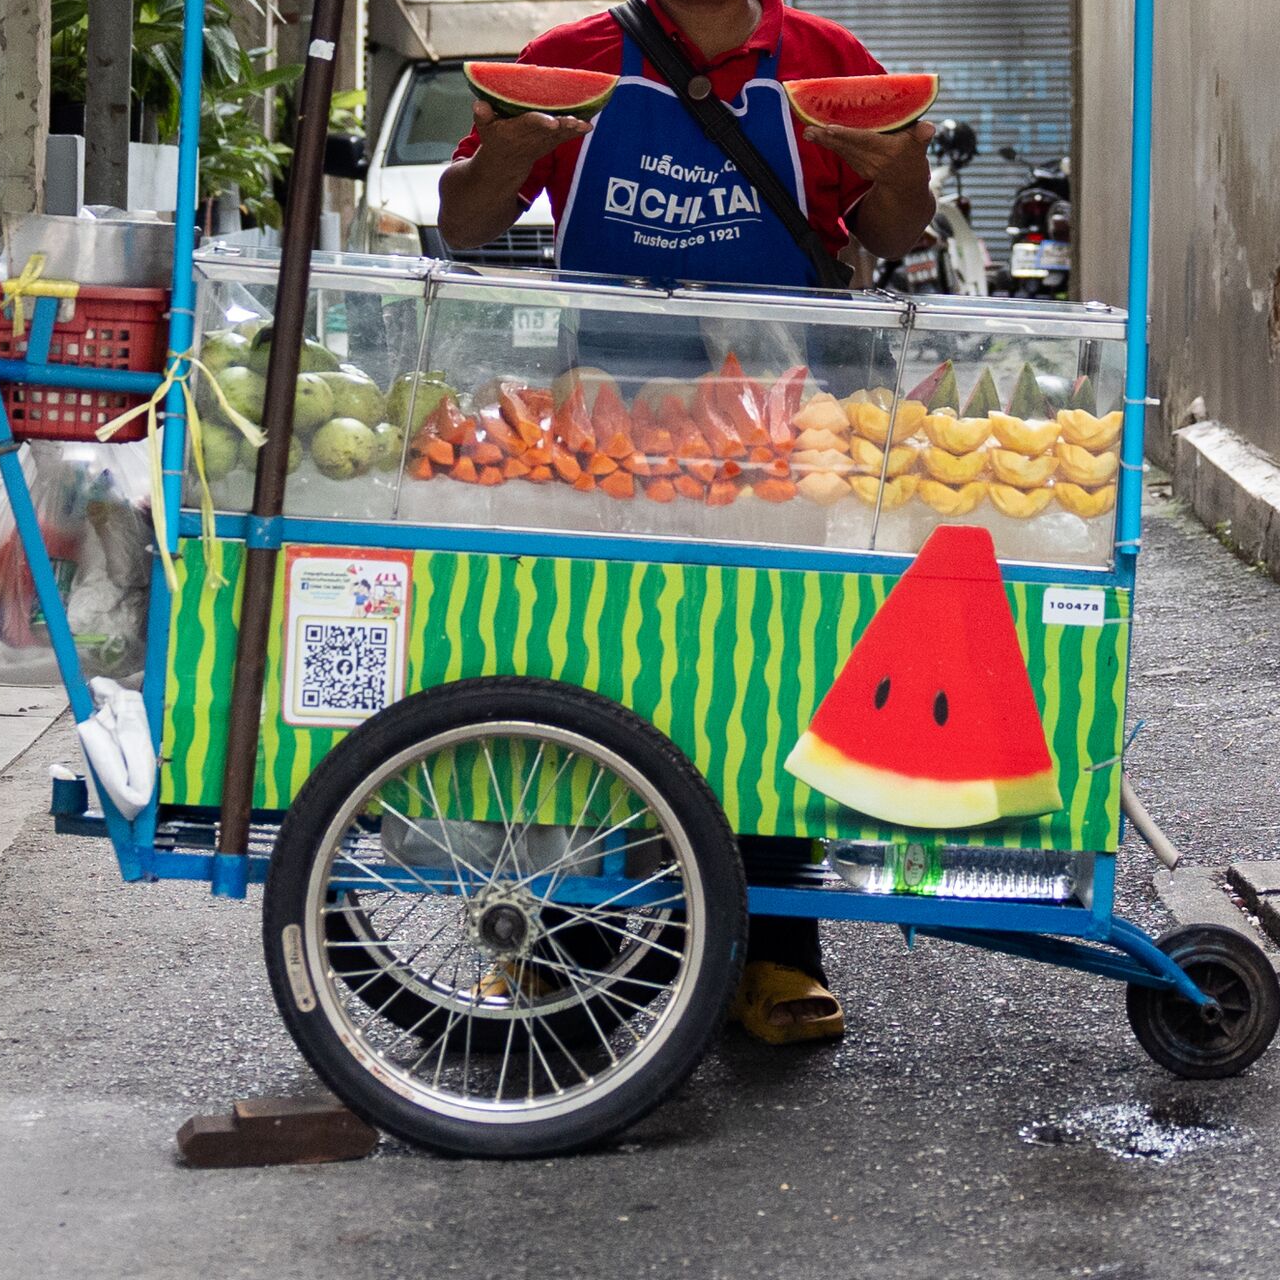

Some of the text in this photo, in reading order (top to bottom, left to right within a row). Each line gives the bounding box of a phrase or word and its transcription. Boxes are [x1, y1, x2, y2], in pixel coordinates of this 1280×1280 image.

[639, 188, 706, 224] CHI
[633, 231, 679, 250] Trusted
[709, 227, 741, 242] 1921
[1050, 601, 1099, 611] 100478
